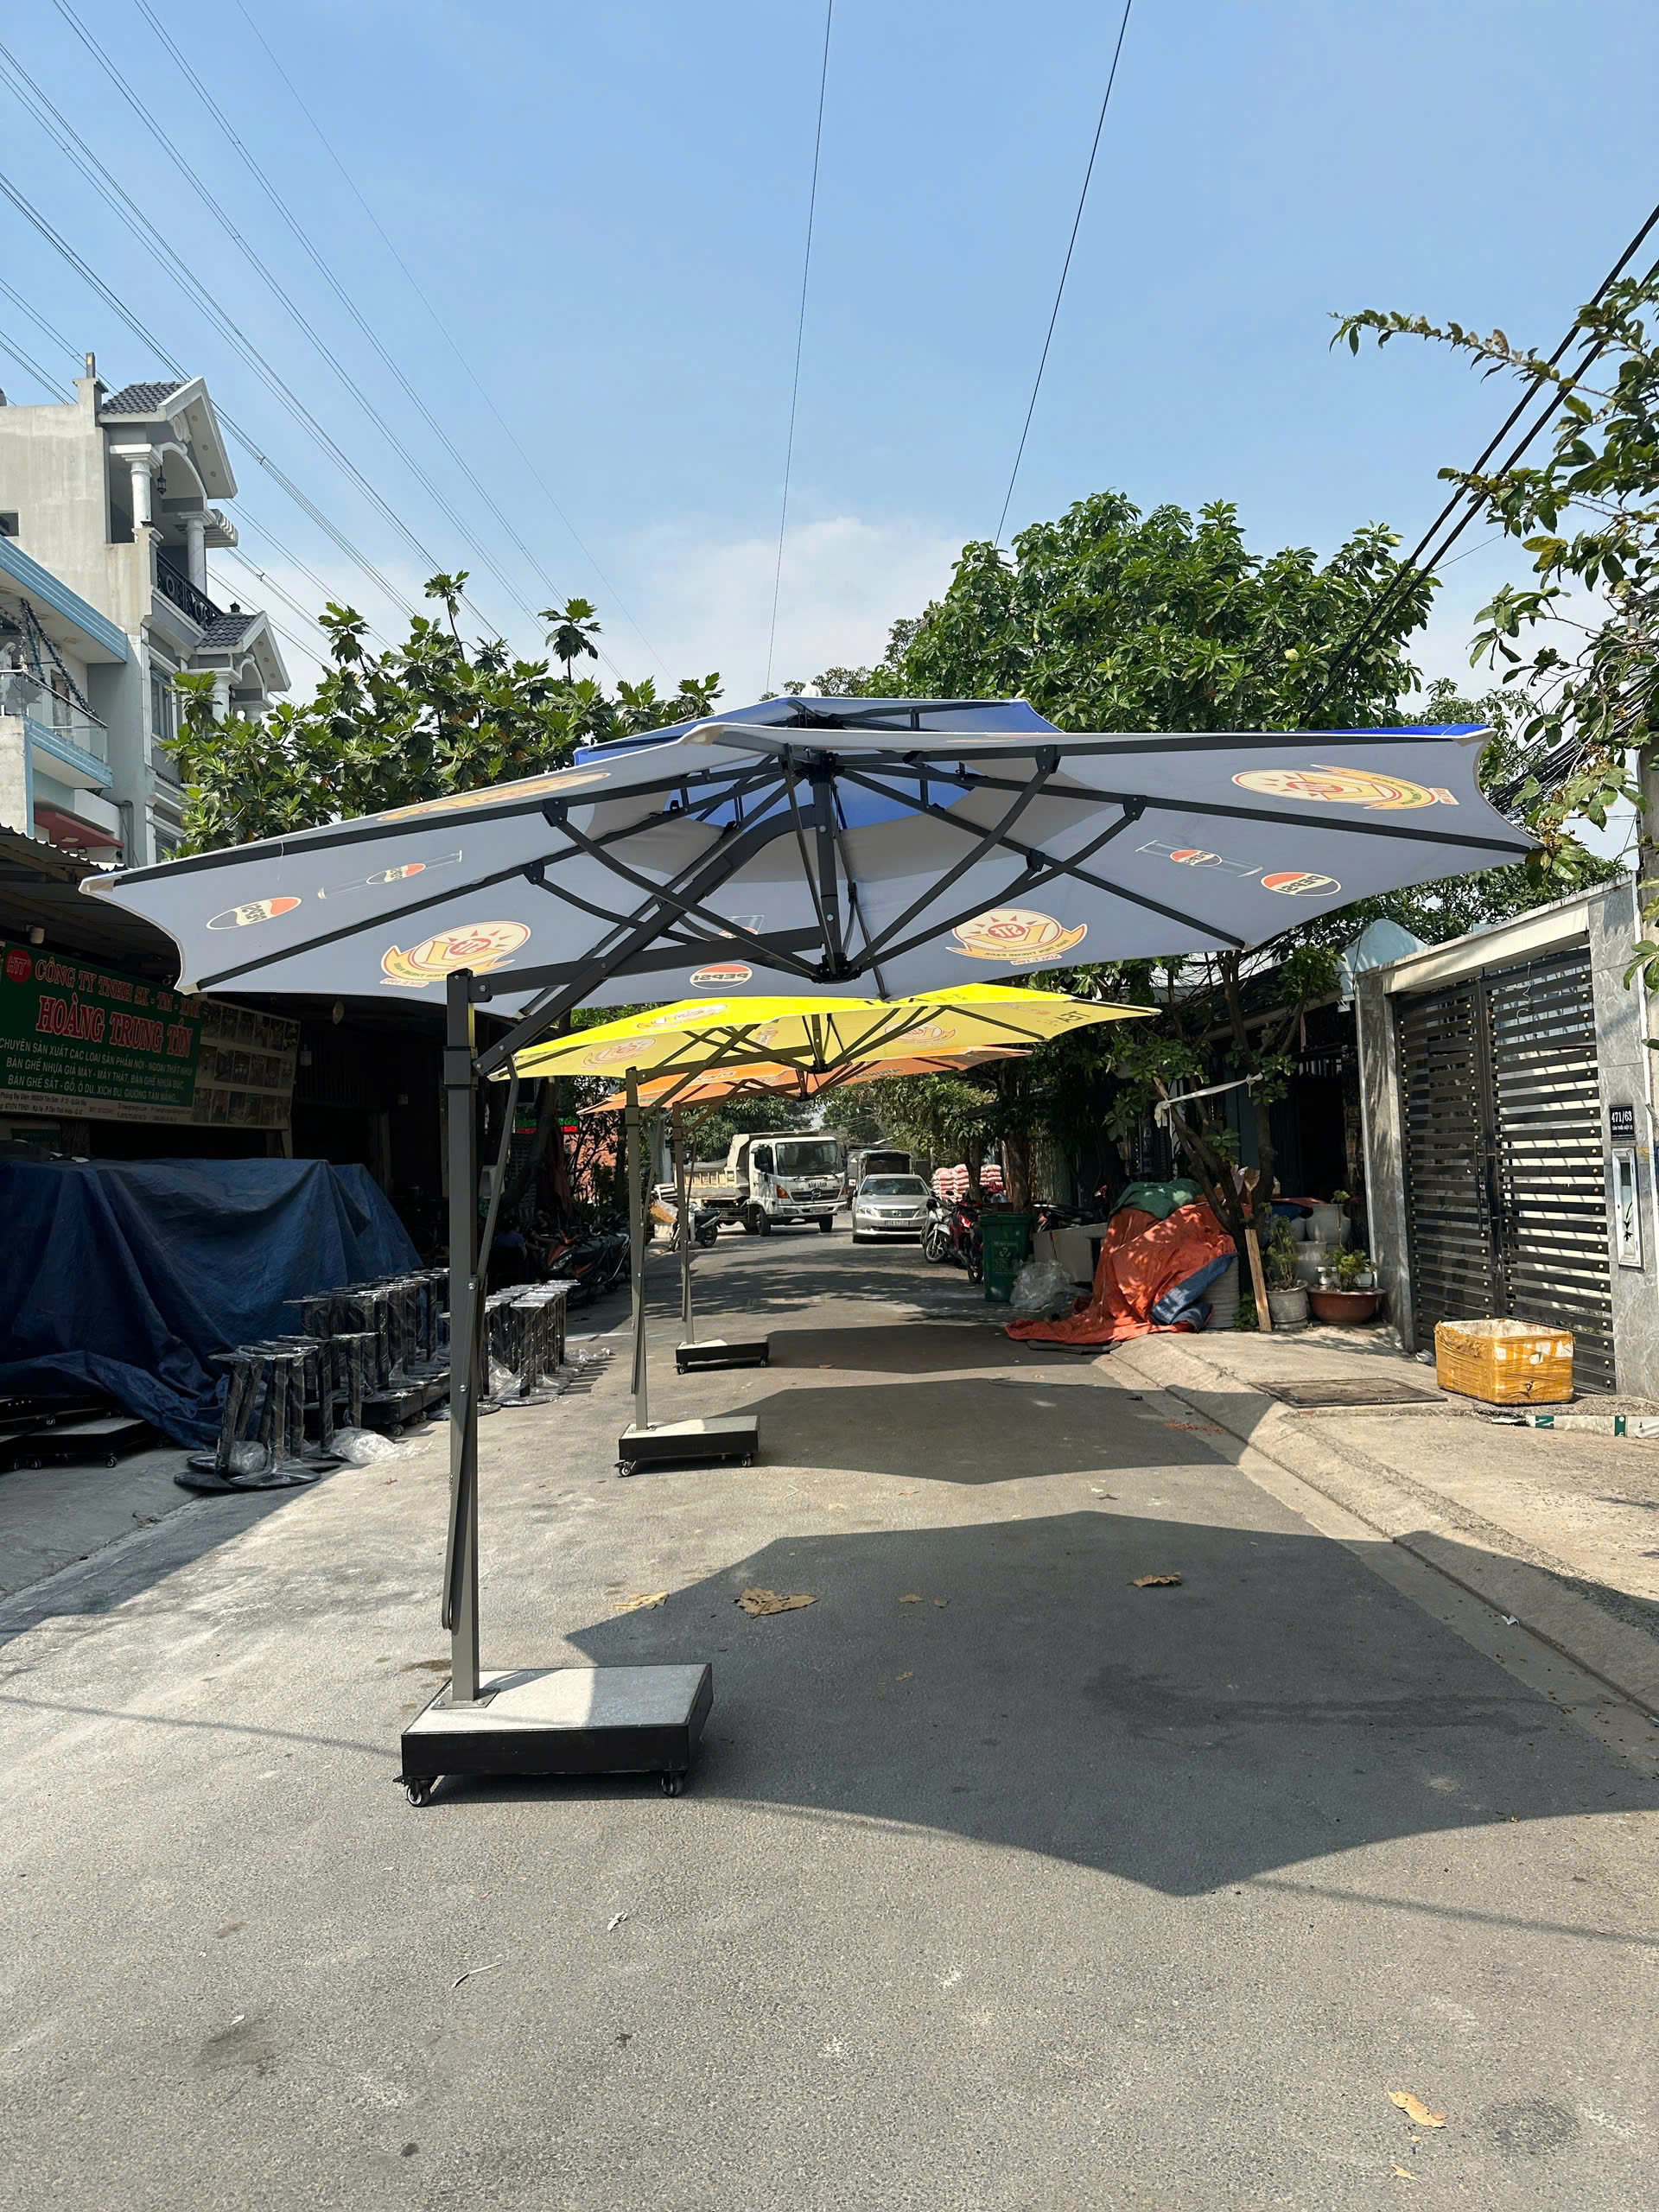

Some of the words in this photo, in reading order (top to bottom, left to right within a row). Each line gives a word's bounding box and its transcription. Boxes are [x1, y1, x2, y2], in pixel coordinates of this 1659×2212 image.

[35, 957, 76, 988] CÔNG
[79, 969, 97, 993] TY
[98, 975, 133, 1002] TNHH
[35, 992, 105, 1044] HOÀNG
[108, 1006, 164, 1054] TRUNG
[167, 1017, 194, 1058] TÍN
[0, 1037, 31, 1052] CHUYÊN
[48, 1044, 69, 1058] XUẤT
[7, 1054, 23, 1070] BÀN
[24, 1057, 42, 1071] GHẾ
[42, 1062, 62, 1076] NHỰA
[8, 1071, 24, 1086] BÀN
[26, 1074, 42, 1087] GHẾ
[1611, 1110, 1632, 1123] 471/63
